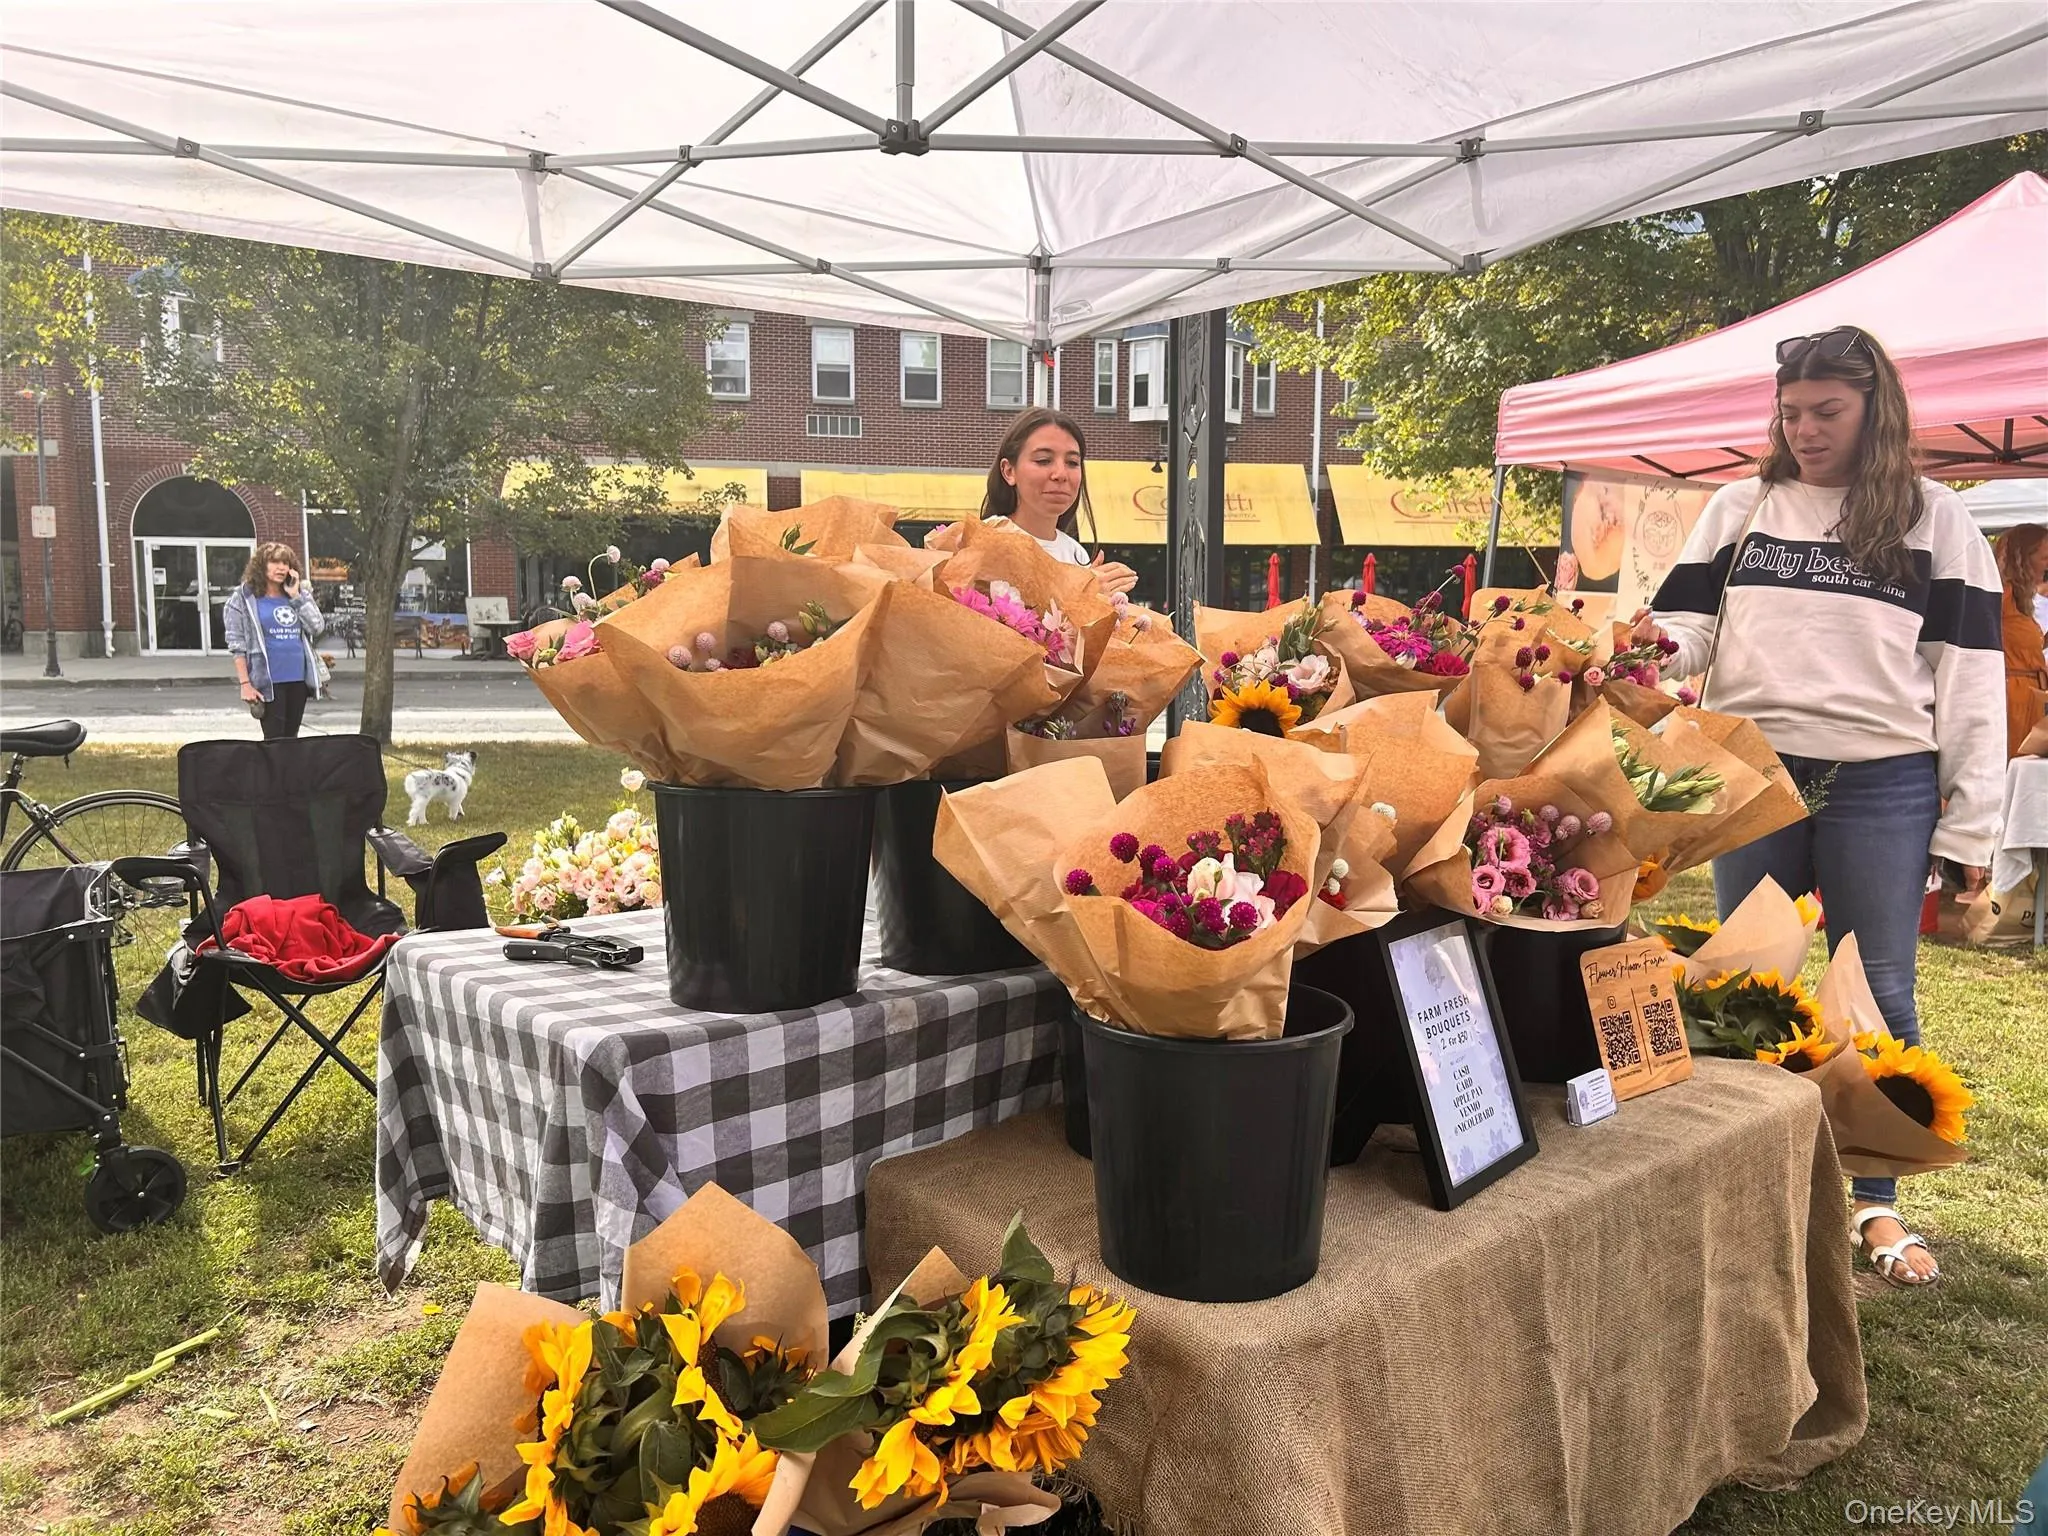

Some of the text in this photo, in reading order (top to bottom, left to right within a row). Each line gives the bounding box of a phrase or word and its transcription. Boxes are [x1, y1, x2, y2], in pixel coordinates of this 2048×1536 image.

[1811, 573, 1849, 585] south
[1585, 961, 1618, 987] Flower
[1640, 949, 1666, 975] Farm
[1417, 993, 1470, 1024] FARM FRESH
[1426, 1010, 1471, 1039] BOUQUETS
[1441, 1038, 1448, 1050] 2
[1453, 1065, 1471, 1081] CASH
[1456, 1077, 1474, 1093] CARD
[1453, 1085, 1484, 1109] APPLE PAY
[1459, 1100, 1481, 1118] VENMO
